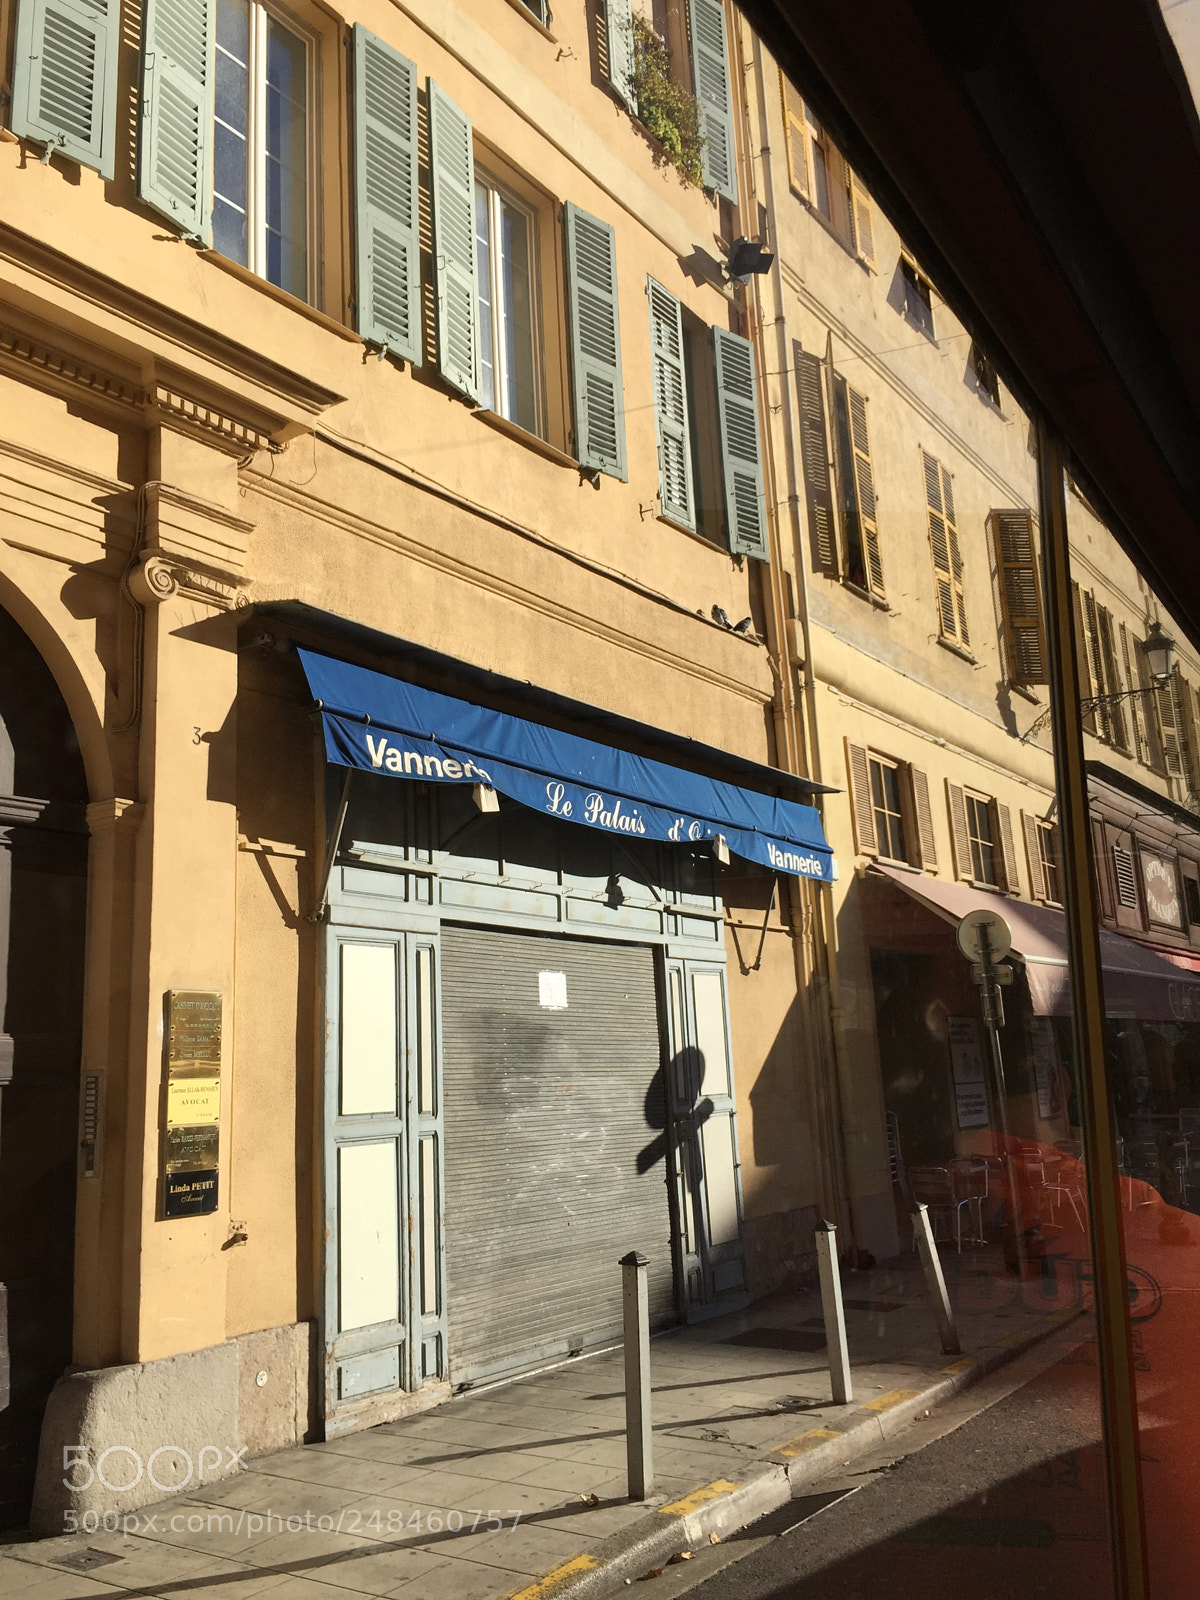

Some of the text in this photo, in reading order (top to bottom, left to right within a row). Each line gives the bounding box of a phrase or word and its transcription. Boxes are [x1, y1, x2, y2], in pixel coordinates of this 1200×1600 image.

[192, 726, 201, 745] 3
[546, 781, 573, 817] Le
[584, 792, 646, 834] Palais
[767, 842, 823, 876] Vannerie
[170, 1181, 214, 1194] Linda PETIT
